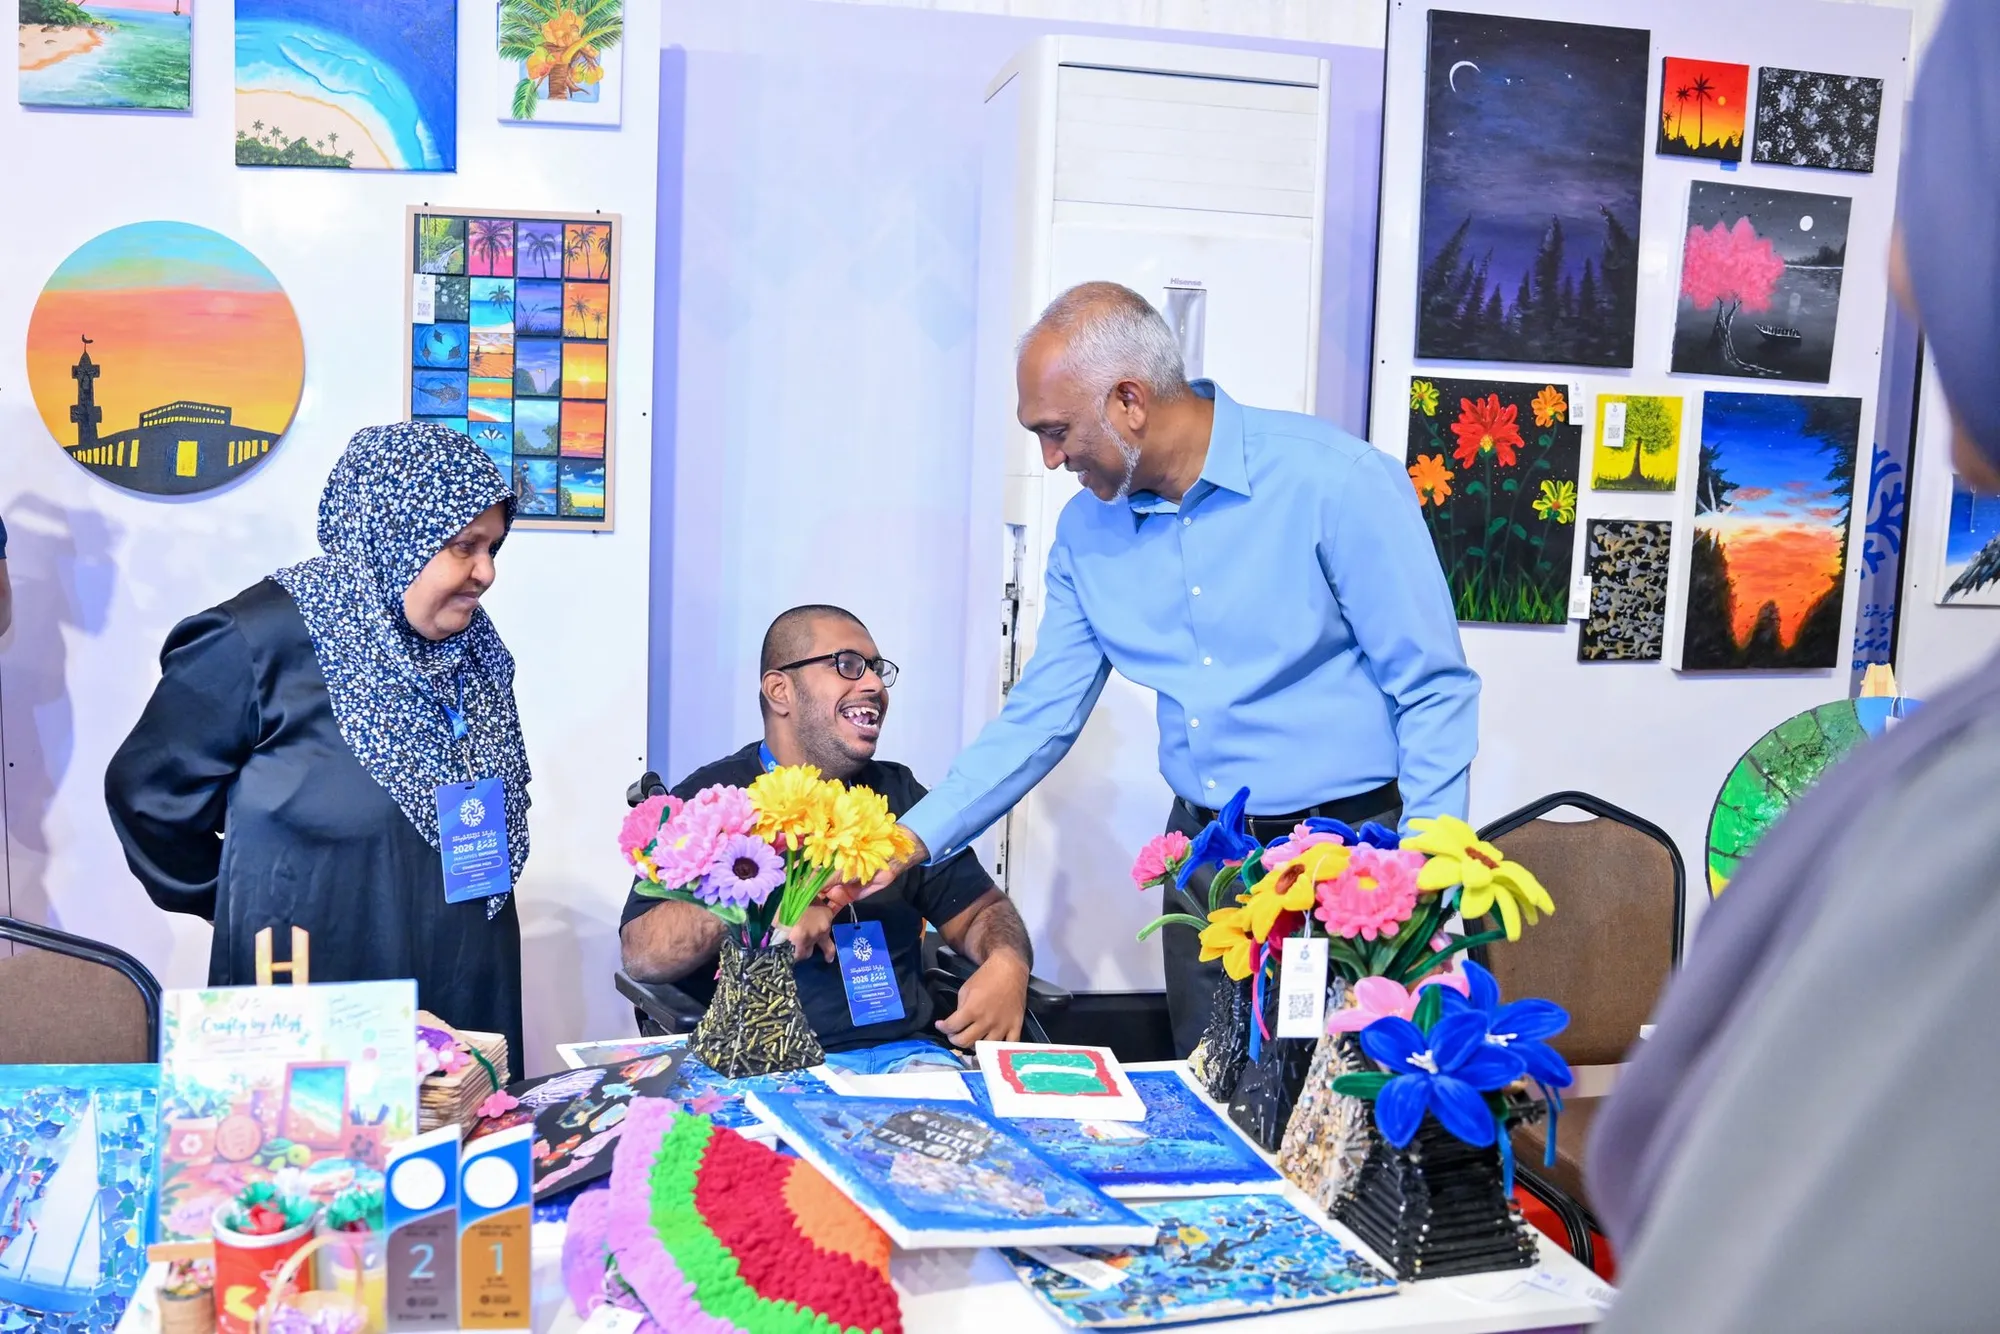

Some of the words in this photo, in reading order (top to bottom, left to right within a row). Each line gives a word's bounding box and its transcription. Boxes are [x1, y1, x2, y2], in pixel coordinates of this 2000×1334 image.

[1170, 278, 1202, 286] Hisense
[453, 843, 474, 854] 2026
[852, 975, 869, 984] 2026
[200, 1016, 247, 1036] Crafty
[251, 1016, 267, 1035] by
[876, 1127, 963, 1163] TRASH
[924, 1128, 984, 1155] YOUR
[408, 1242, 436, 1279] 2
[488, 1241, 504, 1276] 1
